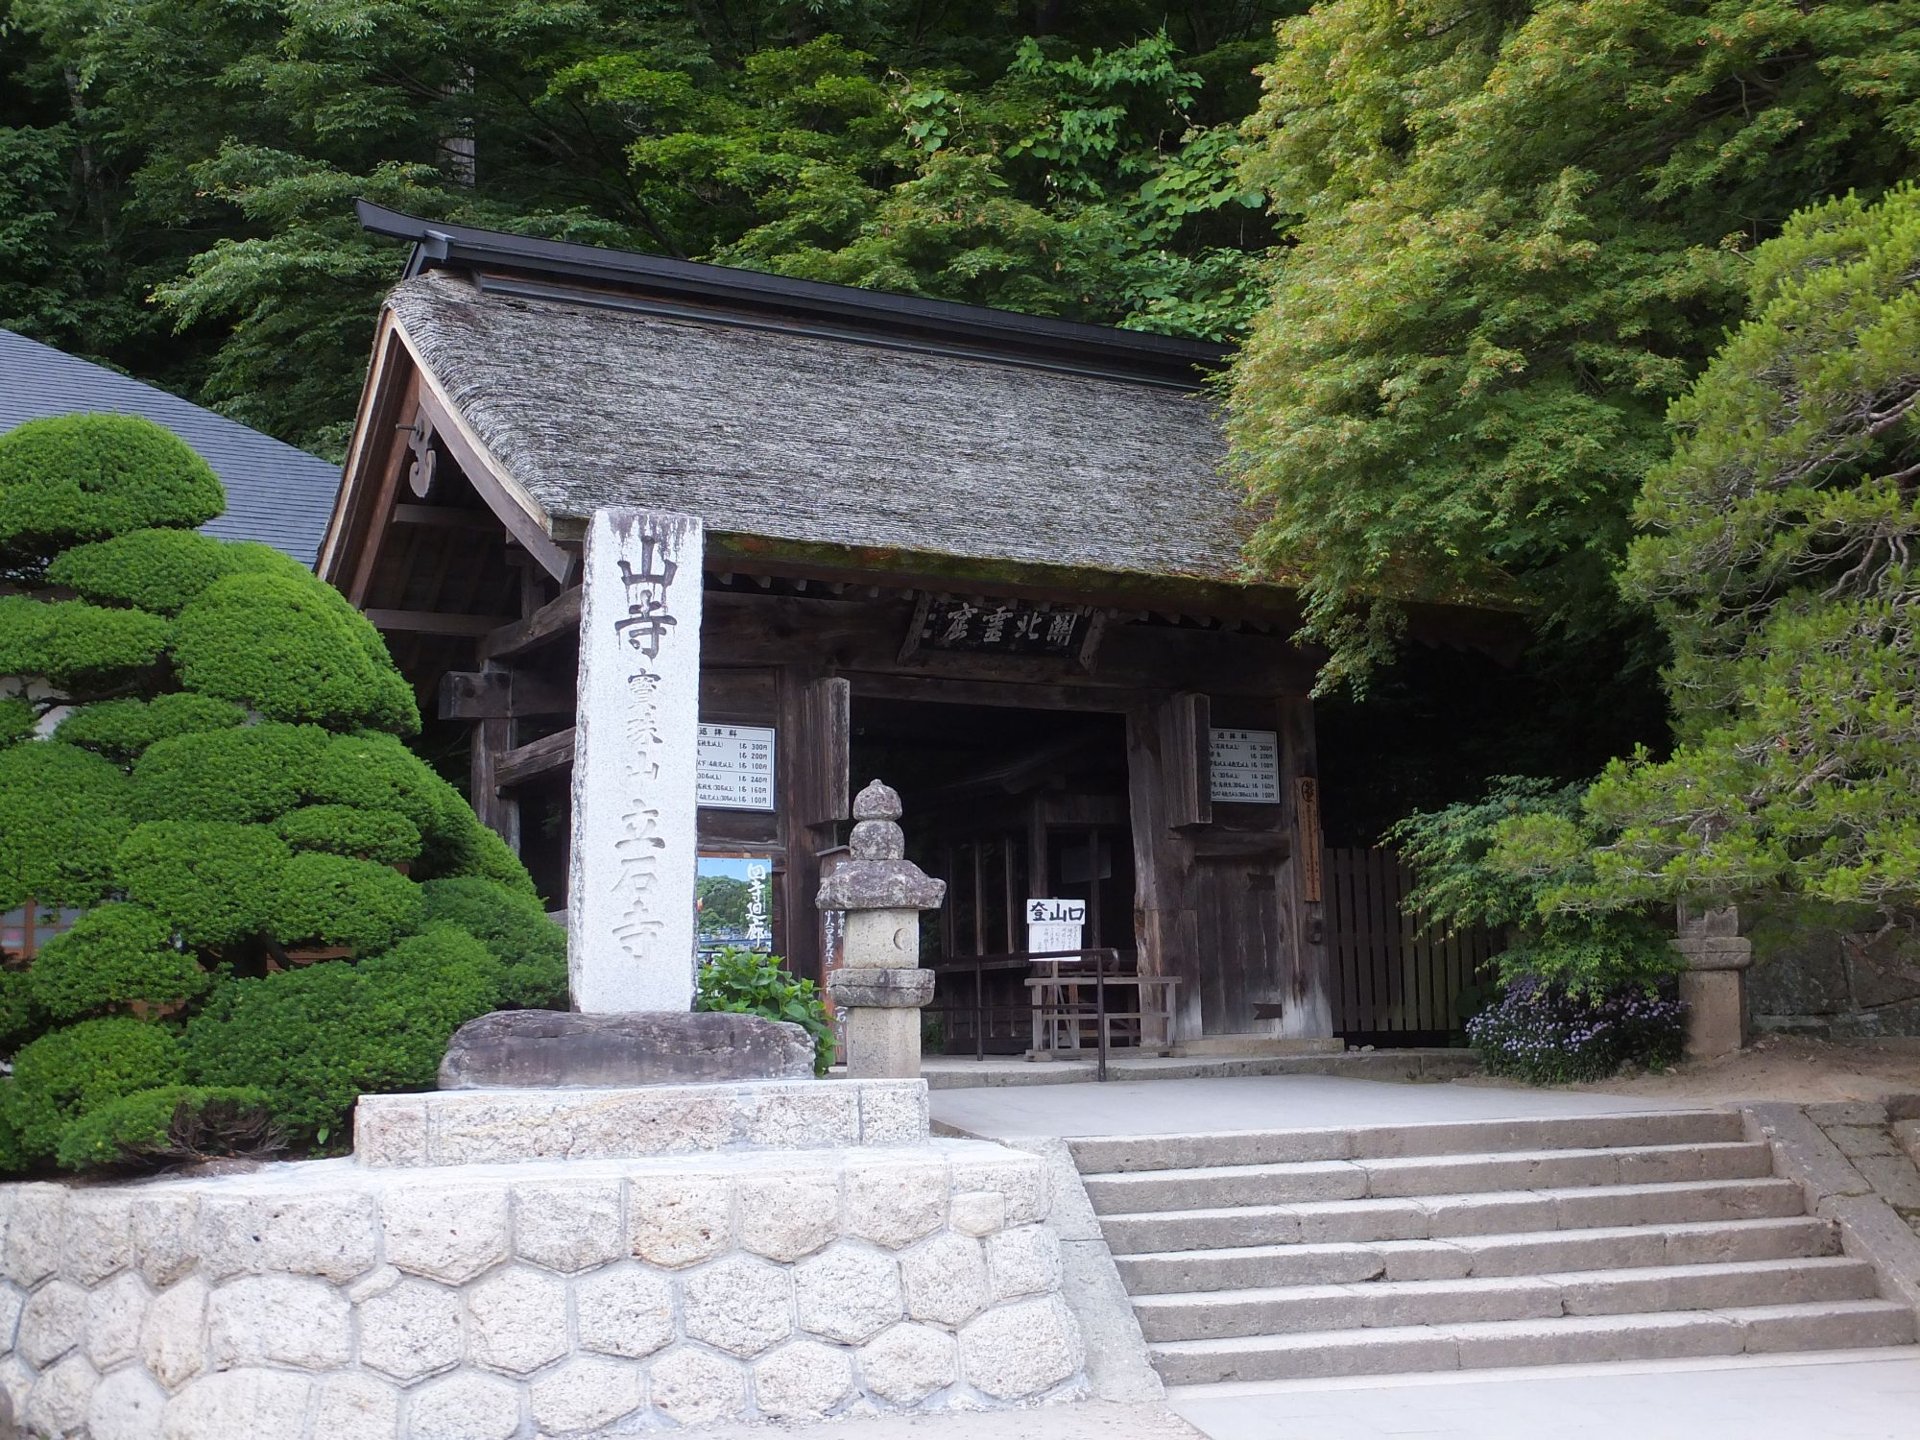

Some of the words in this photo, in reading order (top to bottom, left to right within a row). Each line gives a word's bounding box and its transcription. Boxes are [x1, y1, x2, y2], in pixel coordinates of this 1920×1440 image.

[614, 536, 678, 663] 山寺
[751, 743, 768, 751] 300円
[751, 796, 767, 804] 100円
[610, 798, 666, 960] 立石寺
[1029, 901, 1085, 922] 登山口
